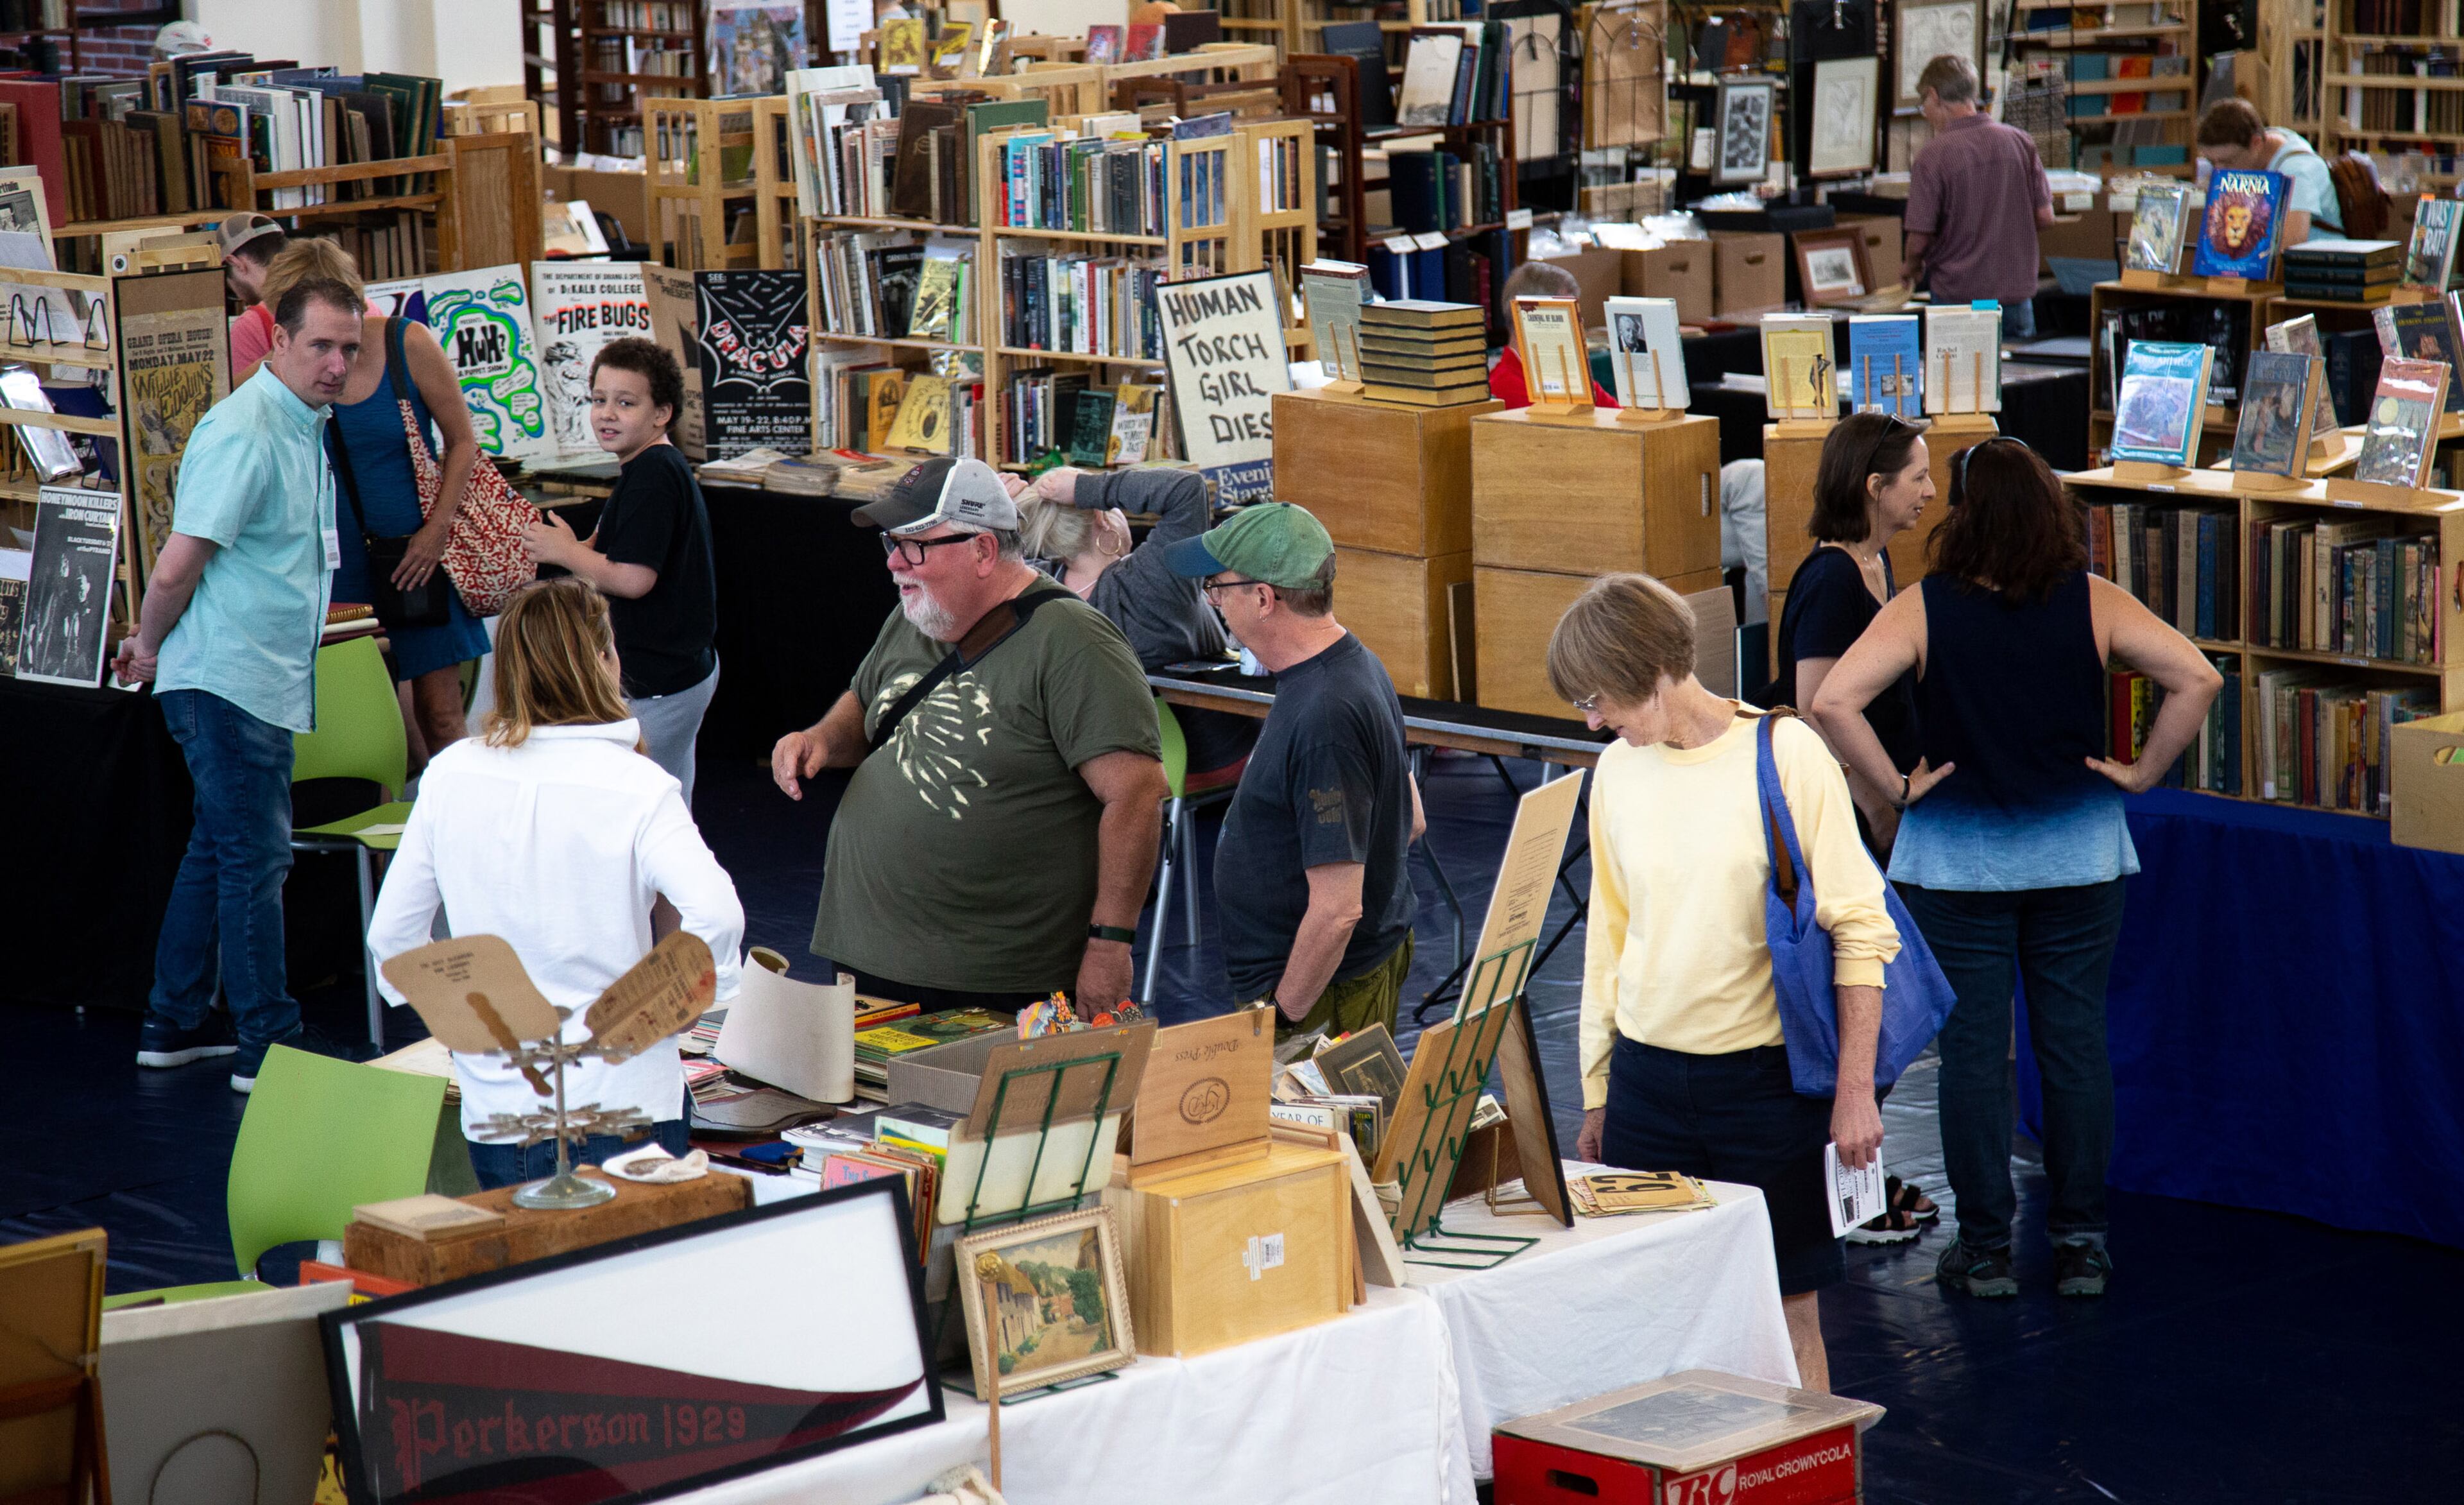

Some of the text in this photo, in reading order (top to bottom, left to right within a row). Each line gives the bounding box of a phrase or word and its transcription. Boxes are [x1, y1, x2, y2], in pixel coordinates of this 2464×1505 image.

[2220, 176, 2270, 197] NARNIA
[600, 284, 643, 294] COLLEGE
[1165, 283, 1263, 327] HUMAN
[557, 304, 597, 335] FIRE
[600, 300, 649, 331] BUGS
[127, 335, 153, 348] GRAND
[158, 332, 183, 345] OPERA
[710, 320, 810, 373] DRACULA
[1177, 332, 1269, 368] TORCH
[178, 350, 201, 366] MAY
[203, 350, 214, 361] 22
[133, 368, 182, 401] WILLIE
[1200, 370, 1268, 406] GIRL
[717, 416, 739, 424] MAY
[726, 426, 805, 434] FINE ARTS CENTER
[1209, 411, 1272, 443] DIES
[1216, 461, 1273, 487] Eveni
[40, 492, 117, 510] HONEYMOON KILLERS
[961, 499, 984, 509] SHURE
[65, 508, 85, 521] IRON
[1176, 1047, 1201, 1062] Press
[1204, 1040, 1238, 1061] Double
[1272, 1112, 1324, 1126] YEAR OF
[386, 1395, 746, 1493] Perkerson 1929
[1740, 1468, 1775, 1491] ROYAL
[1820, 1443, 1851, 1466] COLA
